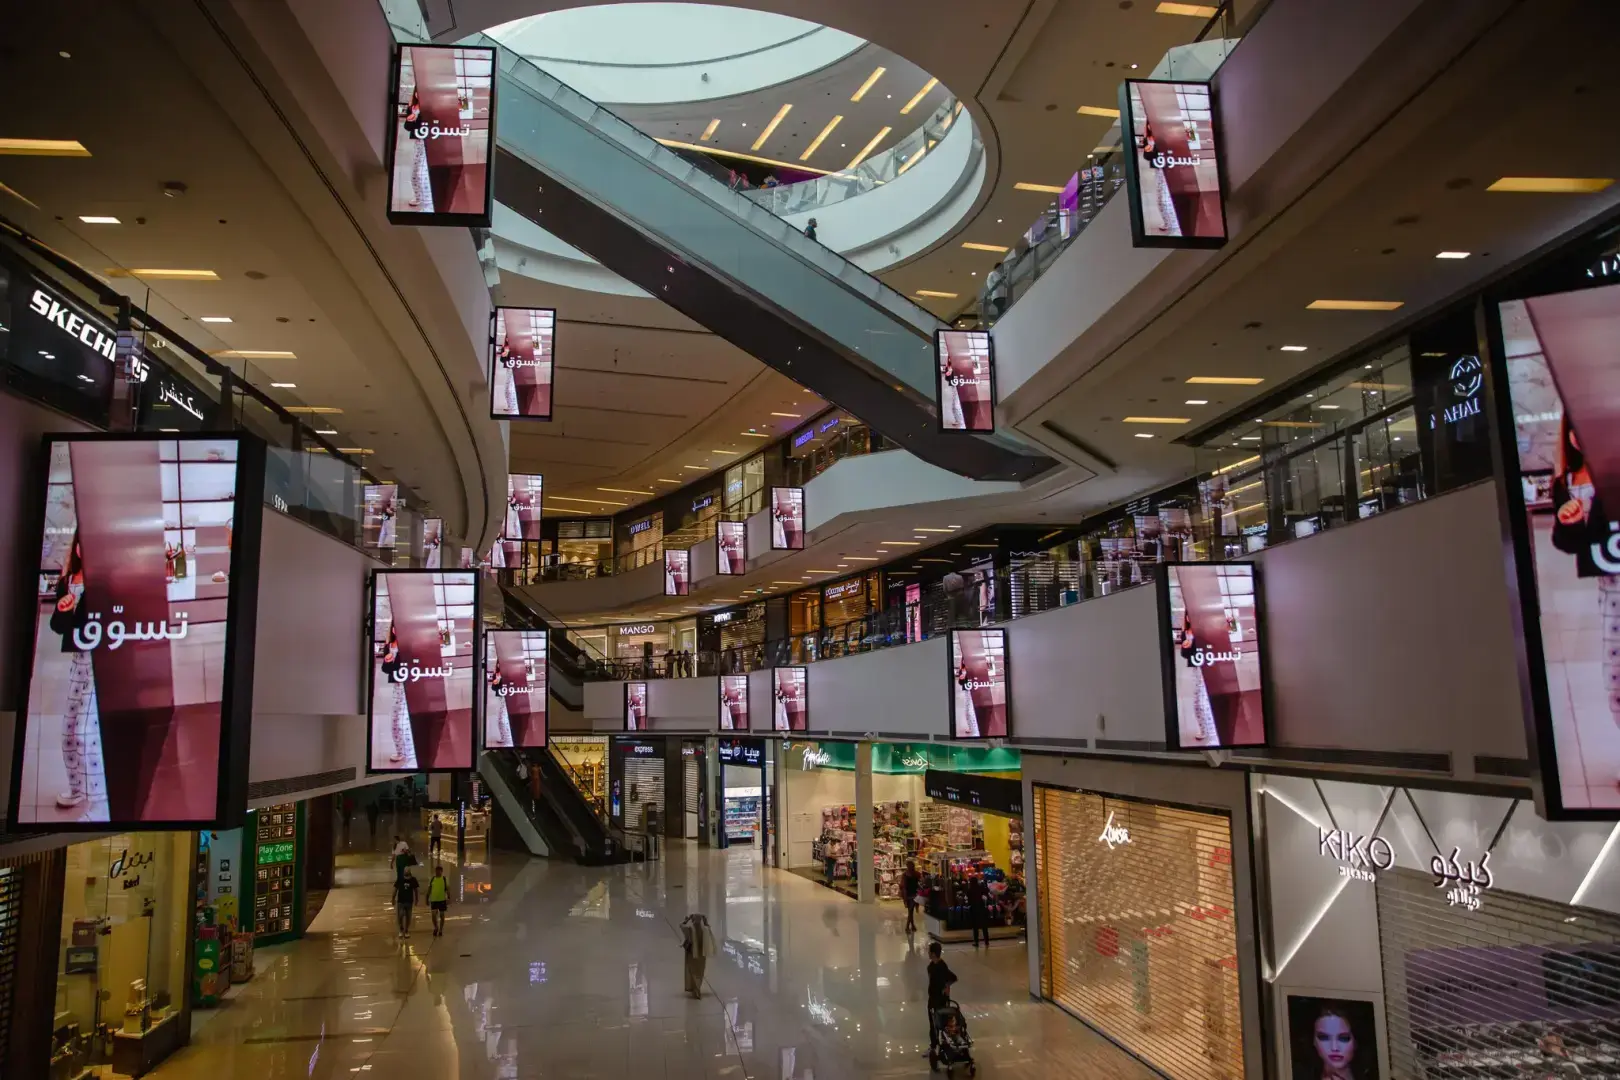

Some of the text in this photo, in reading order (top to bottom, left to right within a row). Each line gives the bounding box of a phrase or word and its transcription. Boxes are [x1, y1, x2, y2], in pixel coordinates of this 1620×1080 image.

[73, 605, 188, 650] تسوّق
[619, 625, 655, 635] MANGO
[258, 843, 293, 854] Play Zone
[1319, 826, 1395, 870] KIKO
[1430, 846, 1493, 889] كيكو
